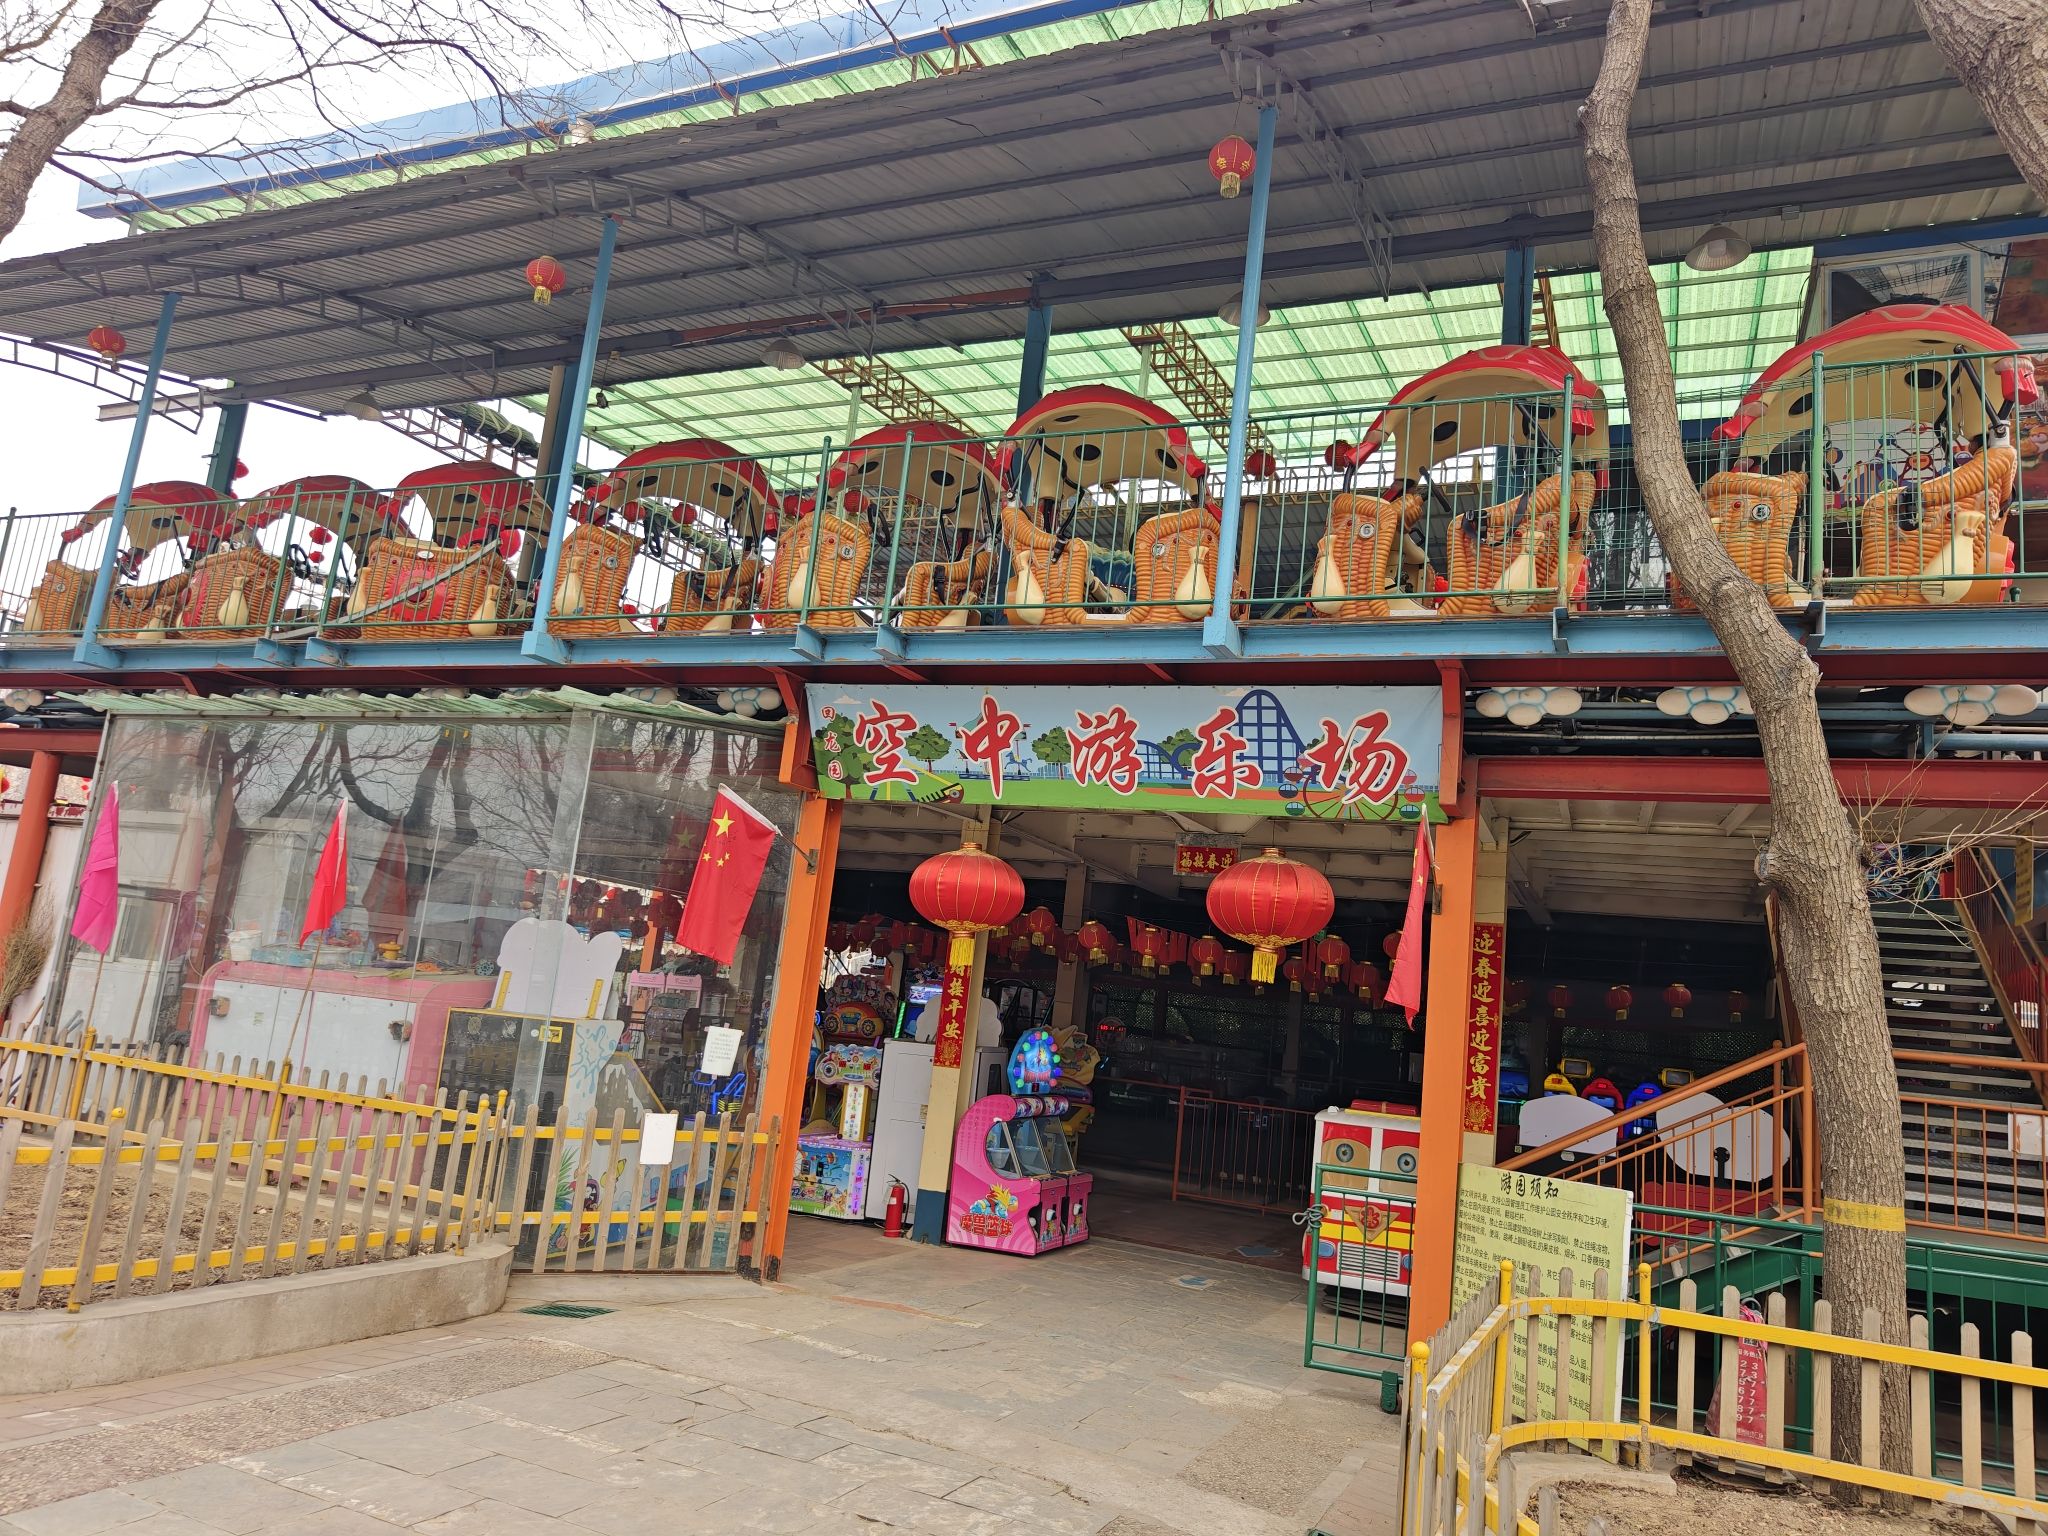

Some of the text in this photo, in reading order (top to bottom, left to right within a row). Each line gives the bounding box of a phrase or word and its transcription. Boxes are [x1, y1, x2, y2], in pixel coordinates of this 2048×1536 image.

[821, 706, 844, 780] 回龙园
[854, 696, 1409, 804] 空中游乐场
[1500, 1172, 1559, 1199] 游园须知
